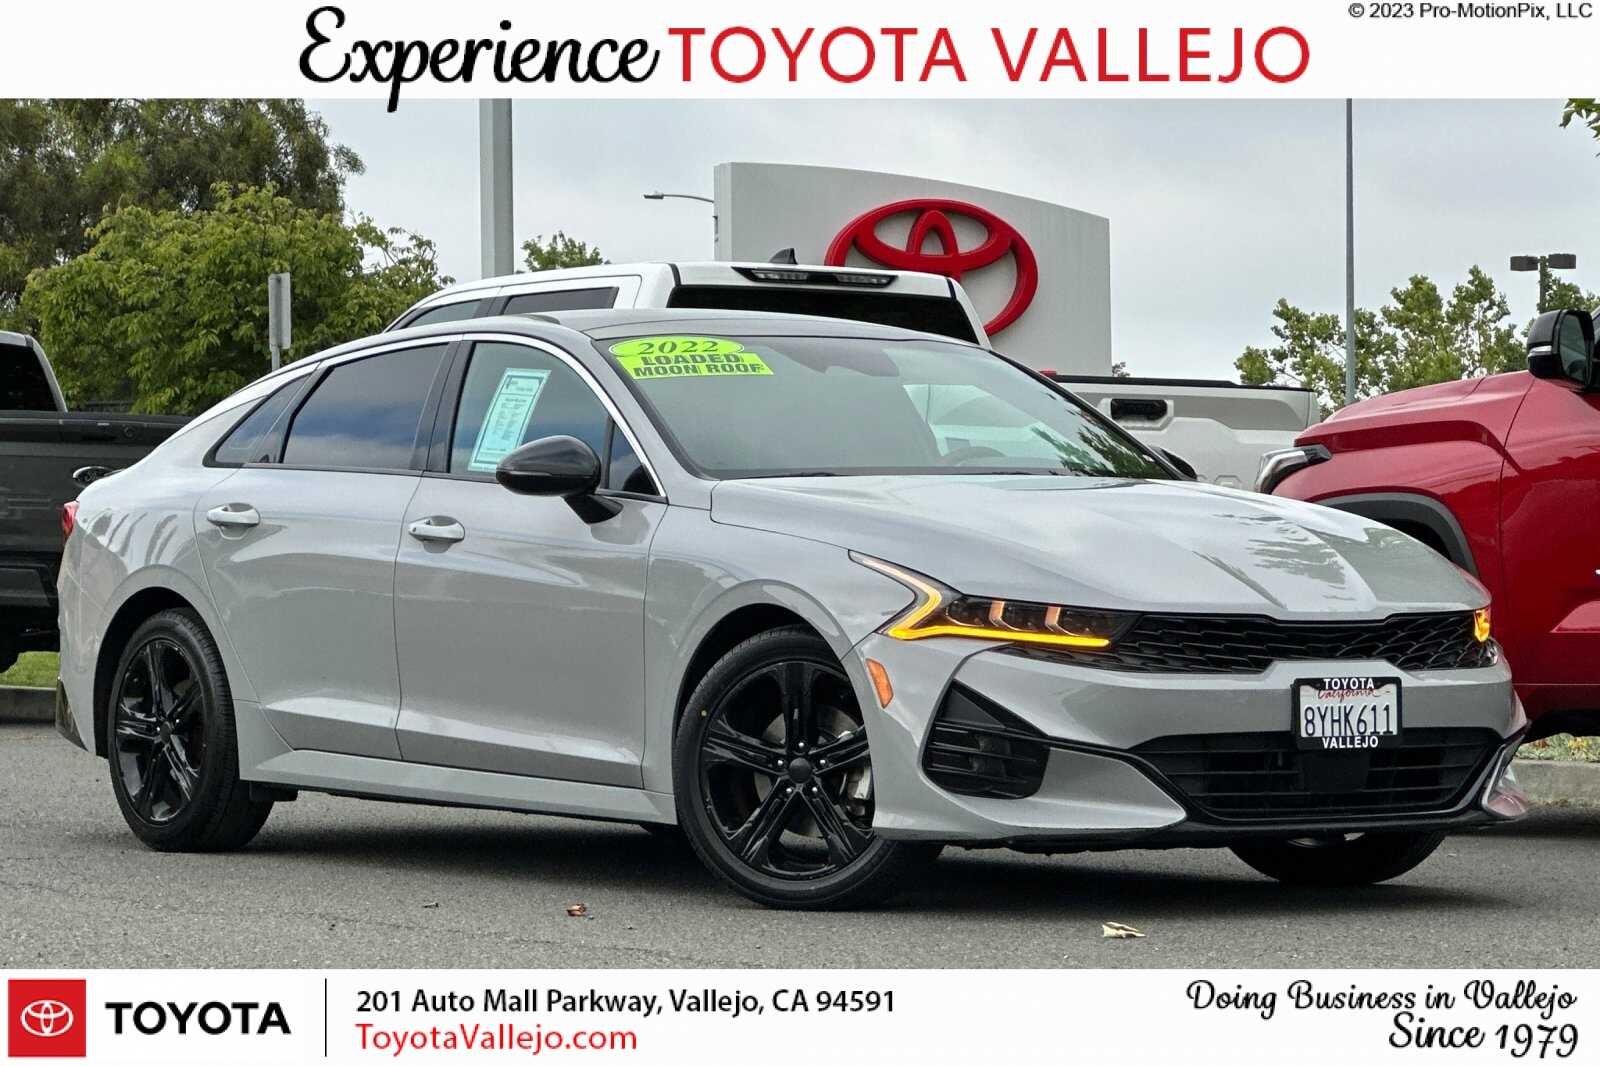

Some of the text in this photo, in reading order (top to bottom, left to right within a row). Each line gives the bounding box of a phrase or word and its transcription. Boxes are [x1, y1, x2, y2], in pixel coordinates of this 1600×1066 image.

[638, 340, 719, 355] 2022
[641, 353, 741, 366] LOADED
[633, 363, 762, 377] MOON ROOF
[1323, 677, 1375, 690] TOYOTA
[1304, 704, 1394, 736] 8YHK611
[1322, 736, 1379, 749] VALLEJO
